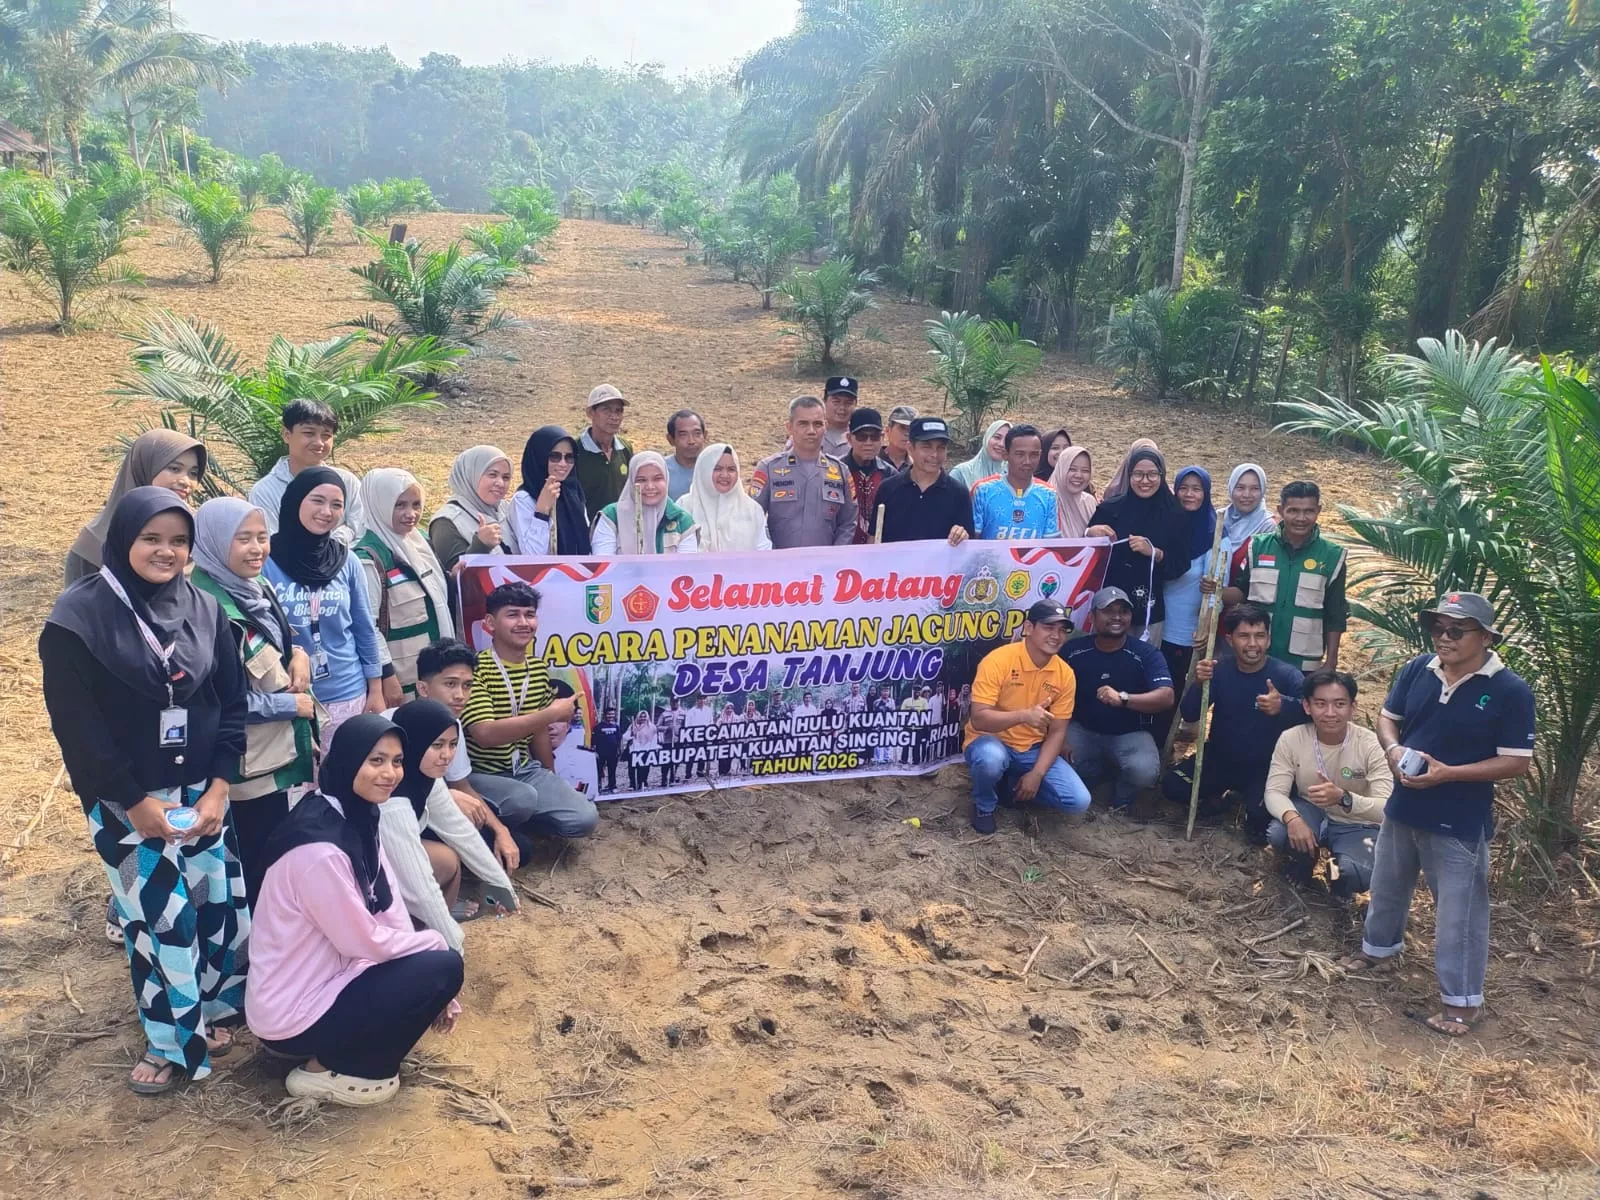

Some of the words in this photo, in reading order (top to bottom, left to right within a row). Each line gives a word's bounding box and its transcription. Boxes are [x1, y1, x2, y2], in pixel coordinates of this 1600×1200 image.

[668, 573, 824, 612] Selamat
[833, 569, 963, 607] Datang
[541, 630, 668, 668] ACARA
[673, 616, 880, 661] PENANAMAN
[882, 611, 1001, 647] JAGUNG
[673, 658, 769, 697] DESA
[783, 649, 943, 688] TANJUNG
[632, 744, 743, 767] KABUPATEN
[748, 735, 833, 760] KUANTAN
[837, 730, 917, 750] SINGINGI
[930, 722, 959, 744] RIAU
[680, 717, 792, 743] KECAMATAN
[796, 712, 844, 735] HULU
[849, 709, 931, 729] KUANTAN
[752, 754, 814, 775] TAHUN
[816, 752, 858, 771] 2026
